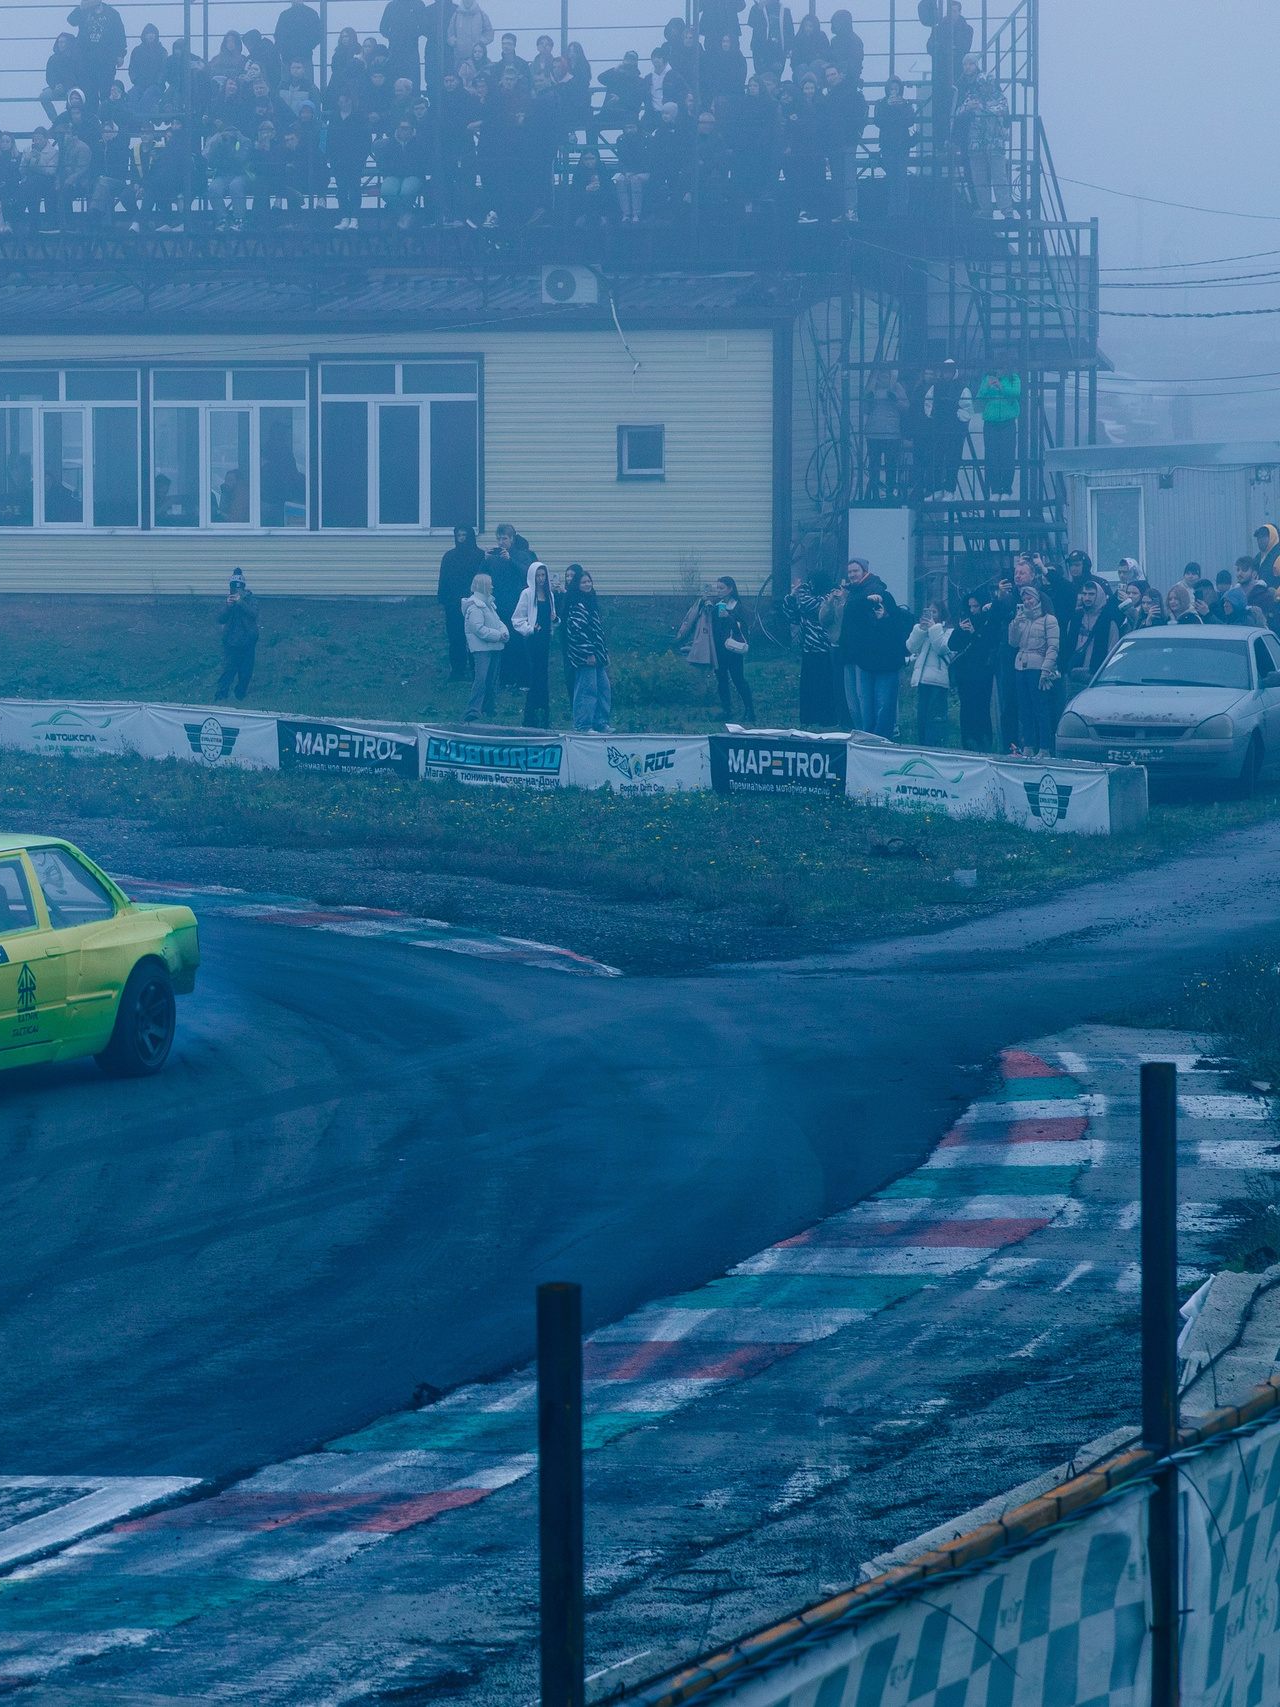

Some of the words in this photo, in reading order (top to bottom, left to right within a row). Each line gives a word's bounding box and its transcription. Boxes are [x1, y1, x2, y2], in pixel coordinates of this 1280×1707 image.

[295, 731, 403, 761] MAPETROL
[426, 739, 562, 771] CLUBTURBO
[643, 748, 677, 774] RDC
[727, 748, 838, 780] MAPETROL
[729, 779, 775, 792] Премиальное
